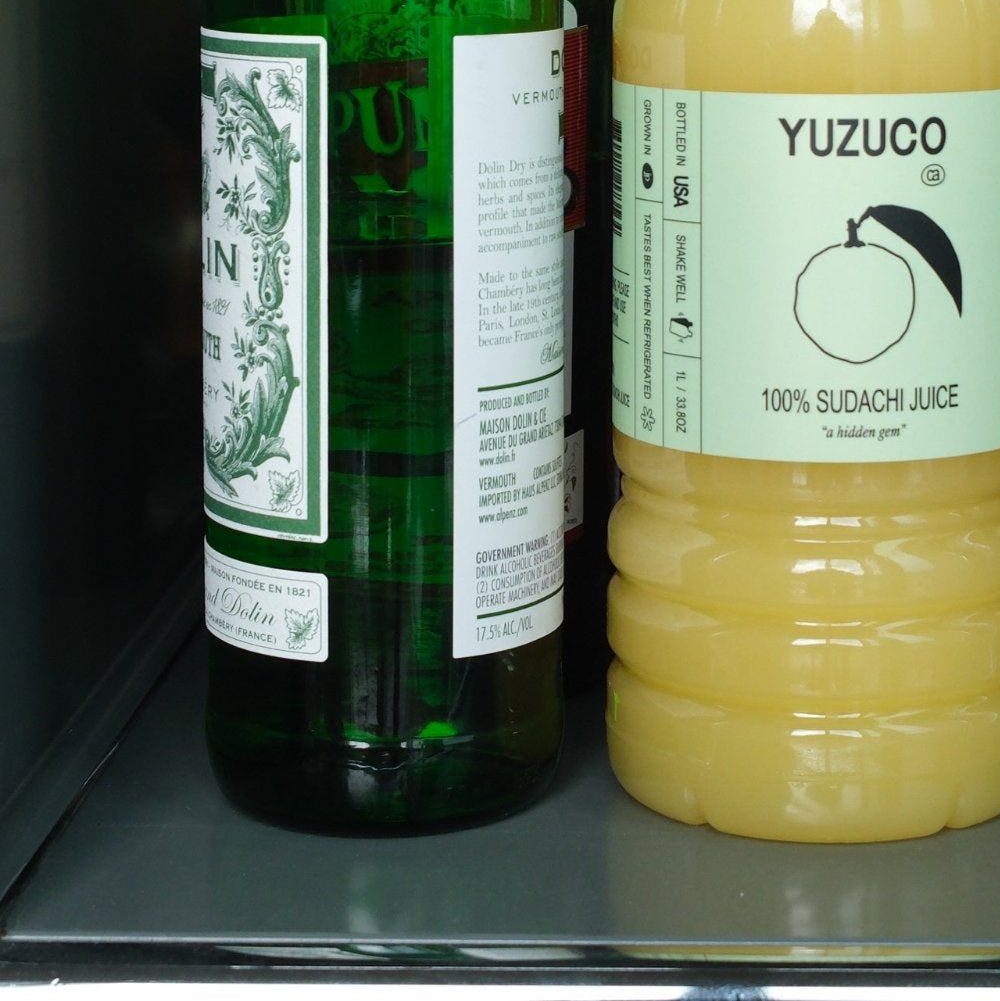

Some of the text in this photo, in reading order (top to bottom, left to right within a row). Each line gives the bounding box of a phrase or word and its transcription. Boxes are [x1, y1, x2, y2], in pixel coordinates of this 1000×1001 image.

[643, 99, 652, 156] GROWN IN
[778, 116, 947, 157] YUZUCO
[673, 102, 690, 208] BOTTLED IN USA
[478, 160, 505, 175] Dolin
[509, 159, 526, 175] Dry
[478, 177, 506, 190] which
[478, 189, 523, 207] herbs and
[478, 206, 527, 226] profile that
[478, 266, 533, 285] Made the
[675, 234, 686, 304] SHAKE WELL
[478, 284, 524, 300] Chambéry
[478, 299, 524, 316] In the late
[643, 214, 652, 400] TASTES BEST WHEN REFRIGERATED
[478, 335, 512, 347] became
[675, 371, 686, 381] 1L
[480, 394, 524, 412] PRODUCED AND
[761, 384, 959, 414] 100% SUDACHI JUICE
[480, 411, 533, 435] MAISON DOLIN
[836, 424, 876, 439] hidden
[479, 435, 506, 452] AVENUE
[479, 472, 516, 491] VERMOUTH
[479, 491, 512, 508] IMPORTED
[476, 543, 524, 564] GOVERNMENT
[476, 554, 532, 580] DRINK ALCOHOLIC
[231, 574, 266, 592] FONDÉE
[268, 584, 282, 595] EN
[287, 586, 311, 598] 1821
[476, 570, 536, 594] (2) CONSUMPTION
[220, 586, 275, 626] Dolin
[476, 591, 506, 609] OPERATE
[235, 626, 277, 644] (FRANCE)
[476, 623, 501, 642] 17.5%
